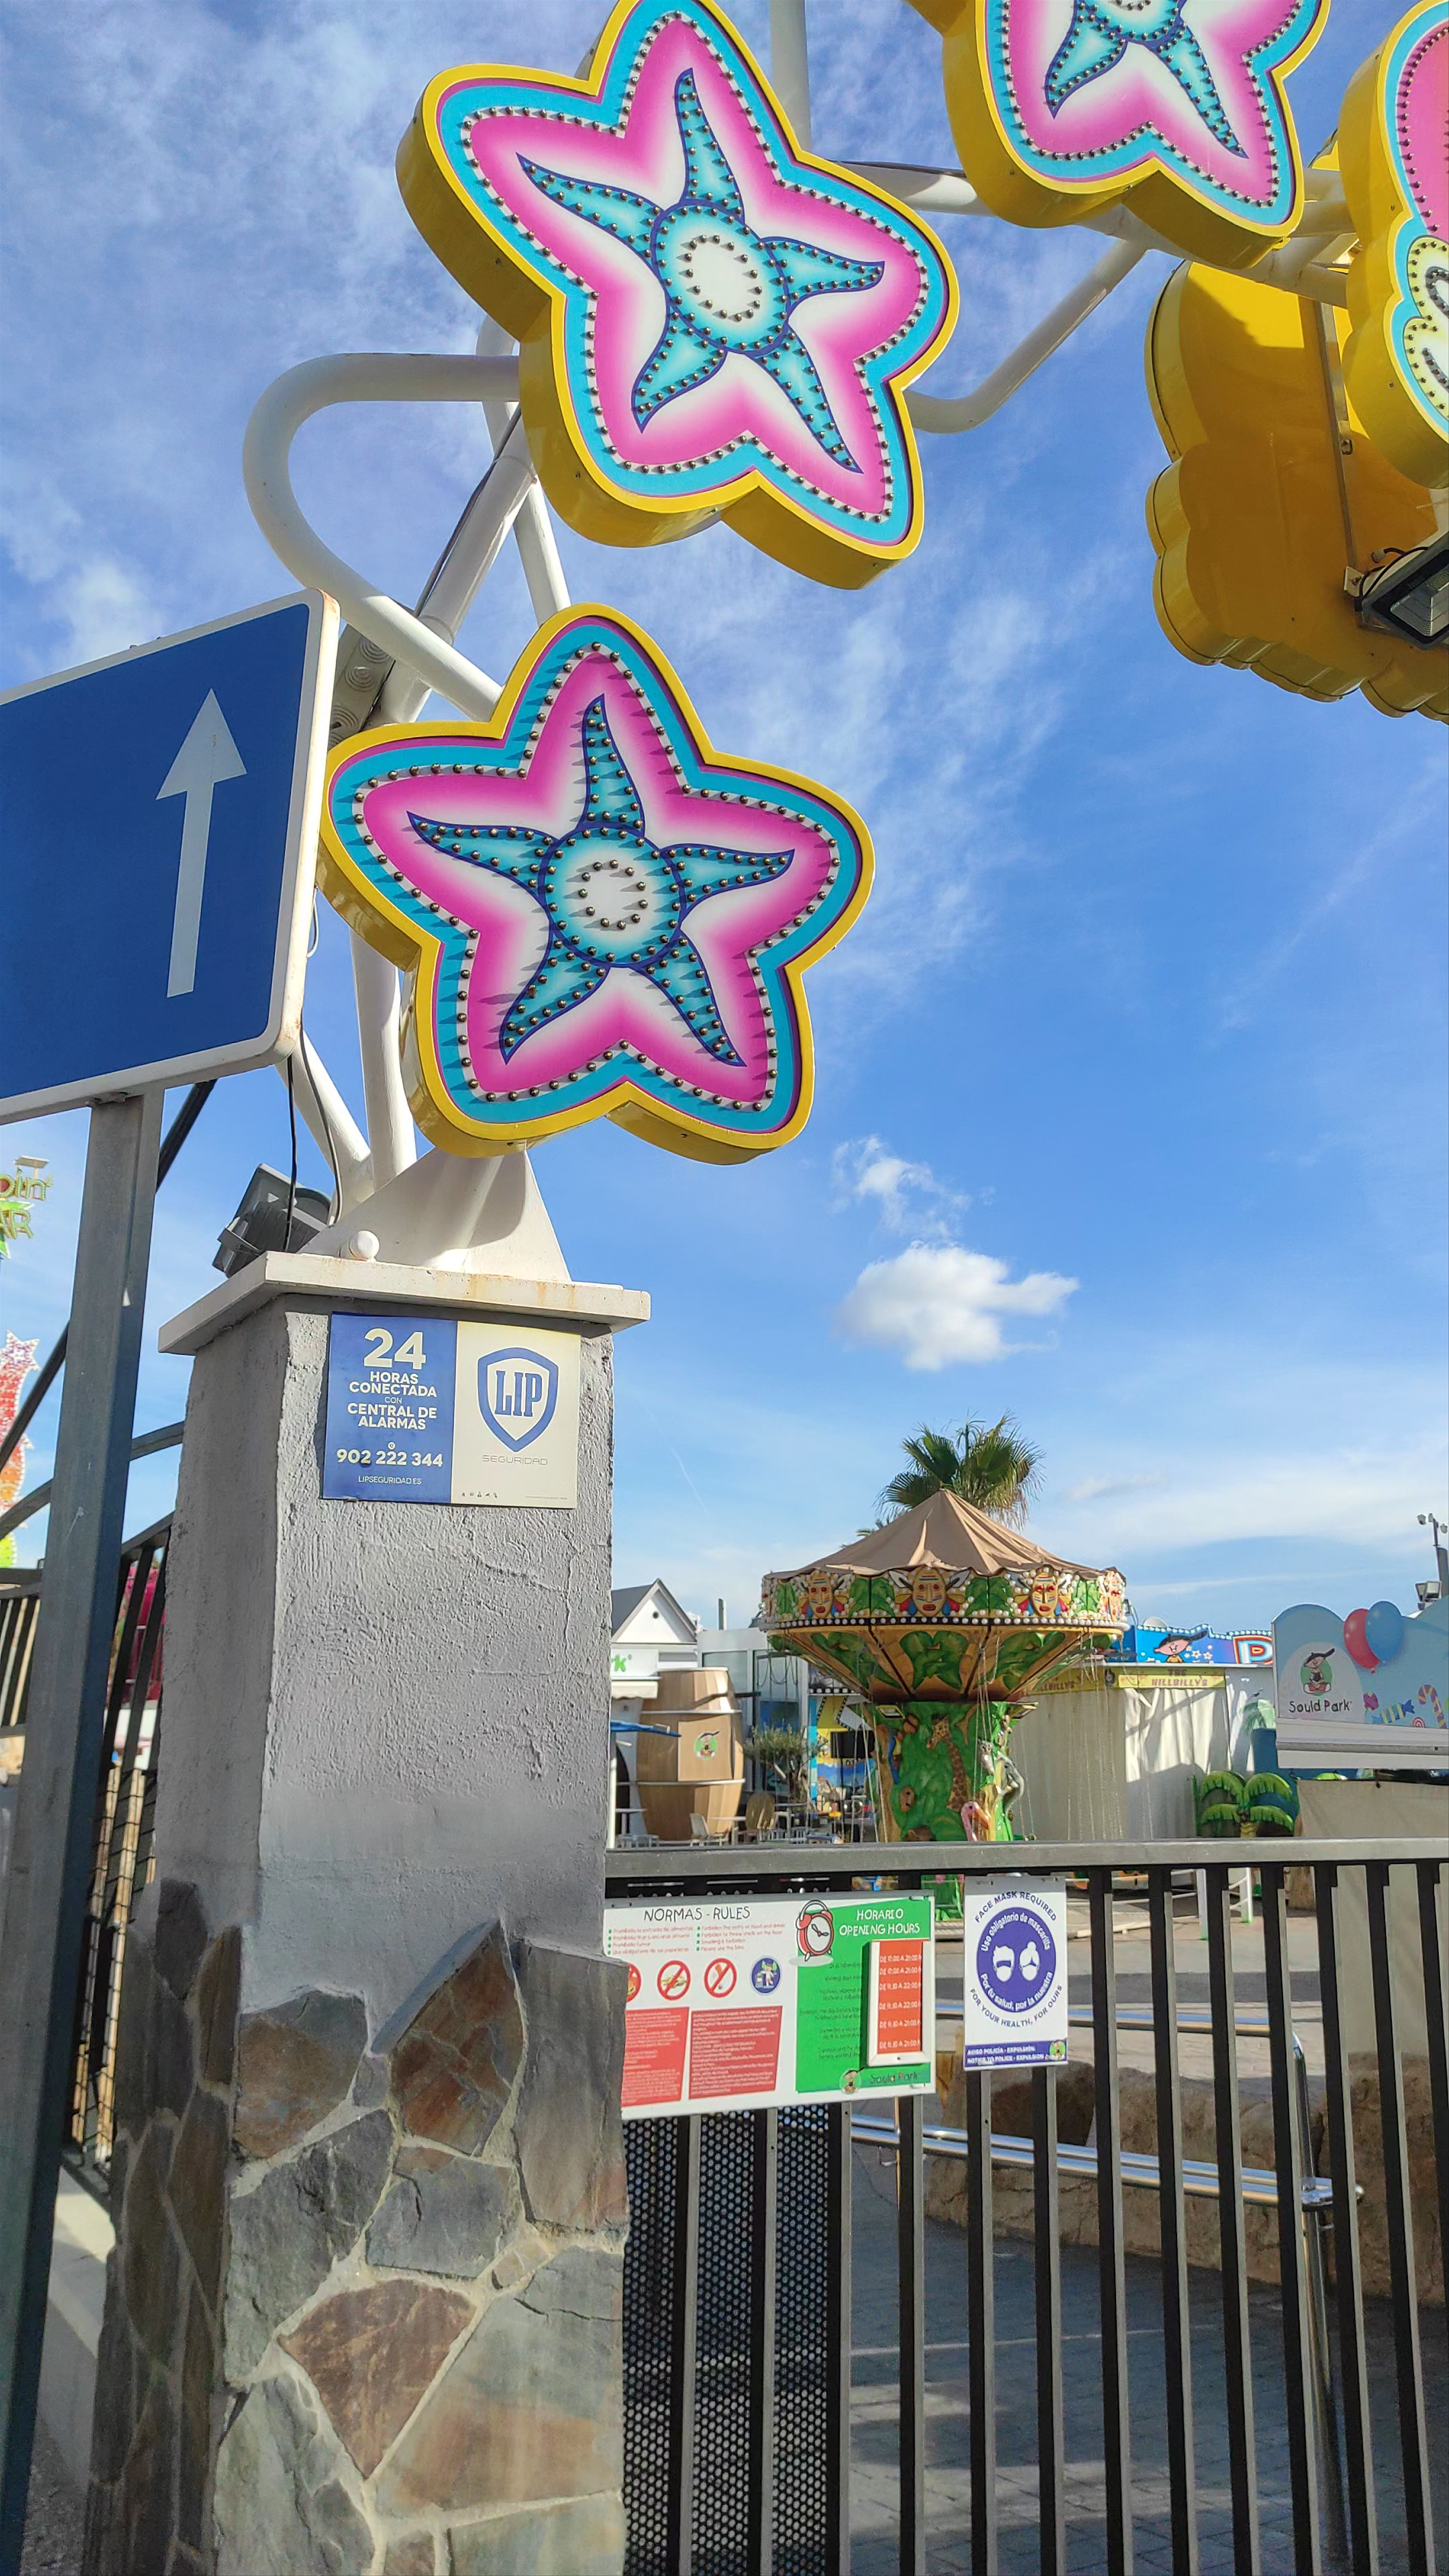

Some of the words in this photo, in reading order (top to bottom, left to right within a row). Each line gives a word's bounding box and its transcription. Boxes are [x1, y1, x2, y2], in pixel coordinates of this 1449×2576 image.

[364, 1328, 426, 1370] 24
[370, 1371, 418, 1384] HORAS
[349, 1381, 437, 1398] CONECTADA
[495, 1370, 542, 1417] LIP
[347, 1403, 414, 1417] CENTRAL
[418, 1407, 437, 1419] DE
[358, 1416, 426, 1430] ALARMAS
[337, 1449, 371, 1464] 902
[376, 1450, 407, 1465] 222
[411, 1453, 443, 1467] 344
[483, 1455, 548, 1465] SEGURIDAD
[1289, 1699, 1321, 1713] Sould
[1324, 1699, 1350, 1712] Park
[644, 1908, 702, 1922] NORMAS
[714, 1906, 750, 1920] RULES
[857, 1908, 903, 1921] HORARIO
[975, 1901, 993, 1922] FACE
[994, 1891, 1017, 1904] MASK
[1020, 1892, 1056, 1921] REQUIRED
[839, 1924, 886, 1936] OPENING
[888, 1923, 920, 1935] HOURS
[981, 1936, 991, 1951] Uso
[989, 1912, 1019, 1936] obligatorio
[1020, 1912, 1028, 1922] de
[1028, 1918, 1051, 1950] mascarilla
[981, 1973, 991, 1989] Por
[988, 1987, 995, 1998] tu
[1015, 2001, 1027, 2011] por
[1027, 1997, 1035, 2006] la
[1034, 1972, 1052, 2000] nuestra
[970, 1989, 981, 2005] FOR
[982, 2005, 999, 2023] YOUR
[1034, 2007, 1048, 2021] FOR
[1048, 1985, 1062, 2007] OURS
